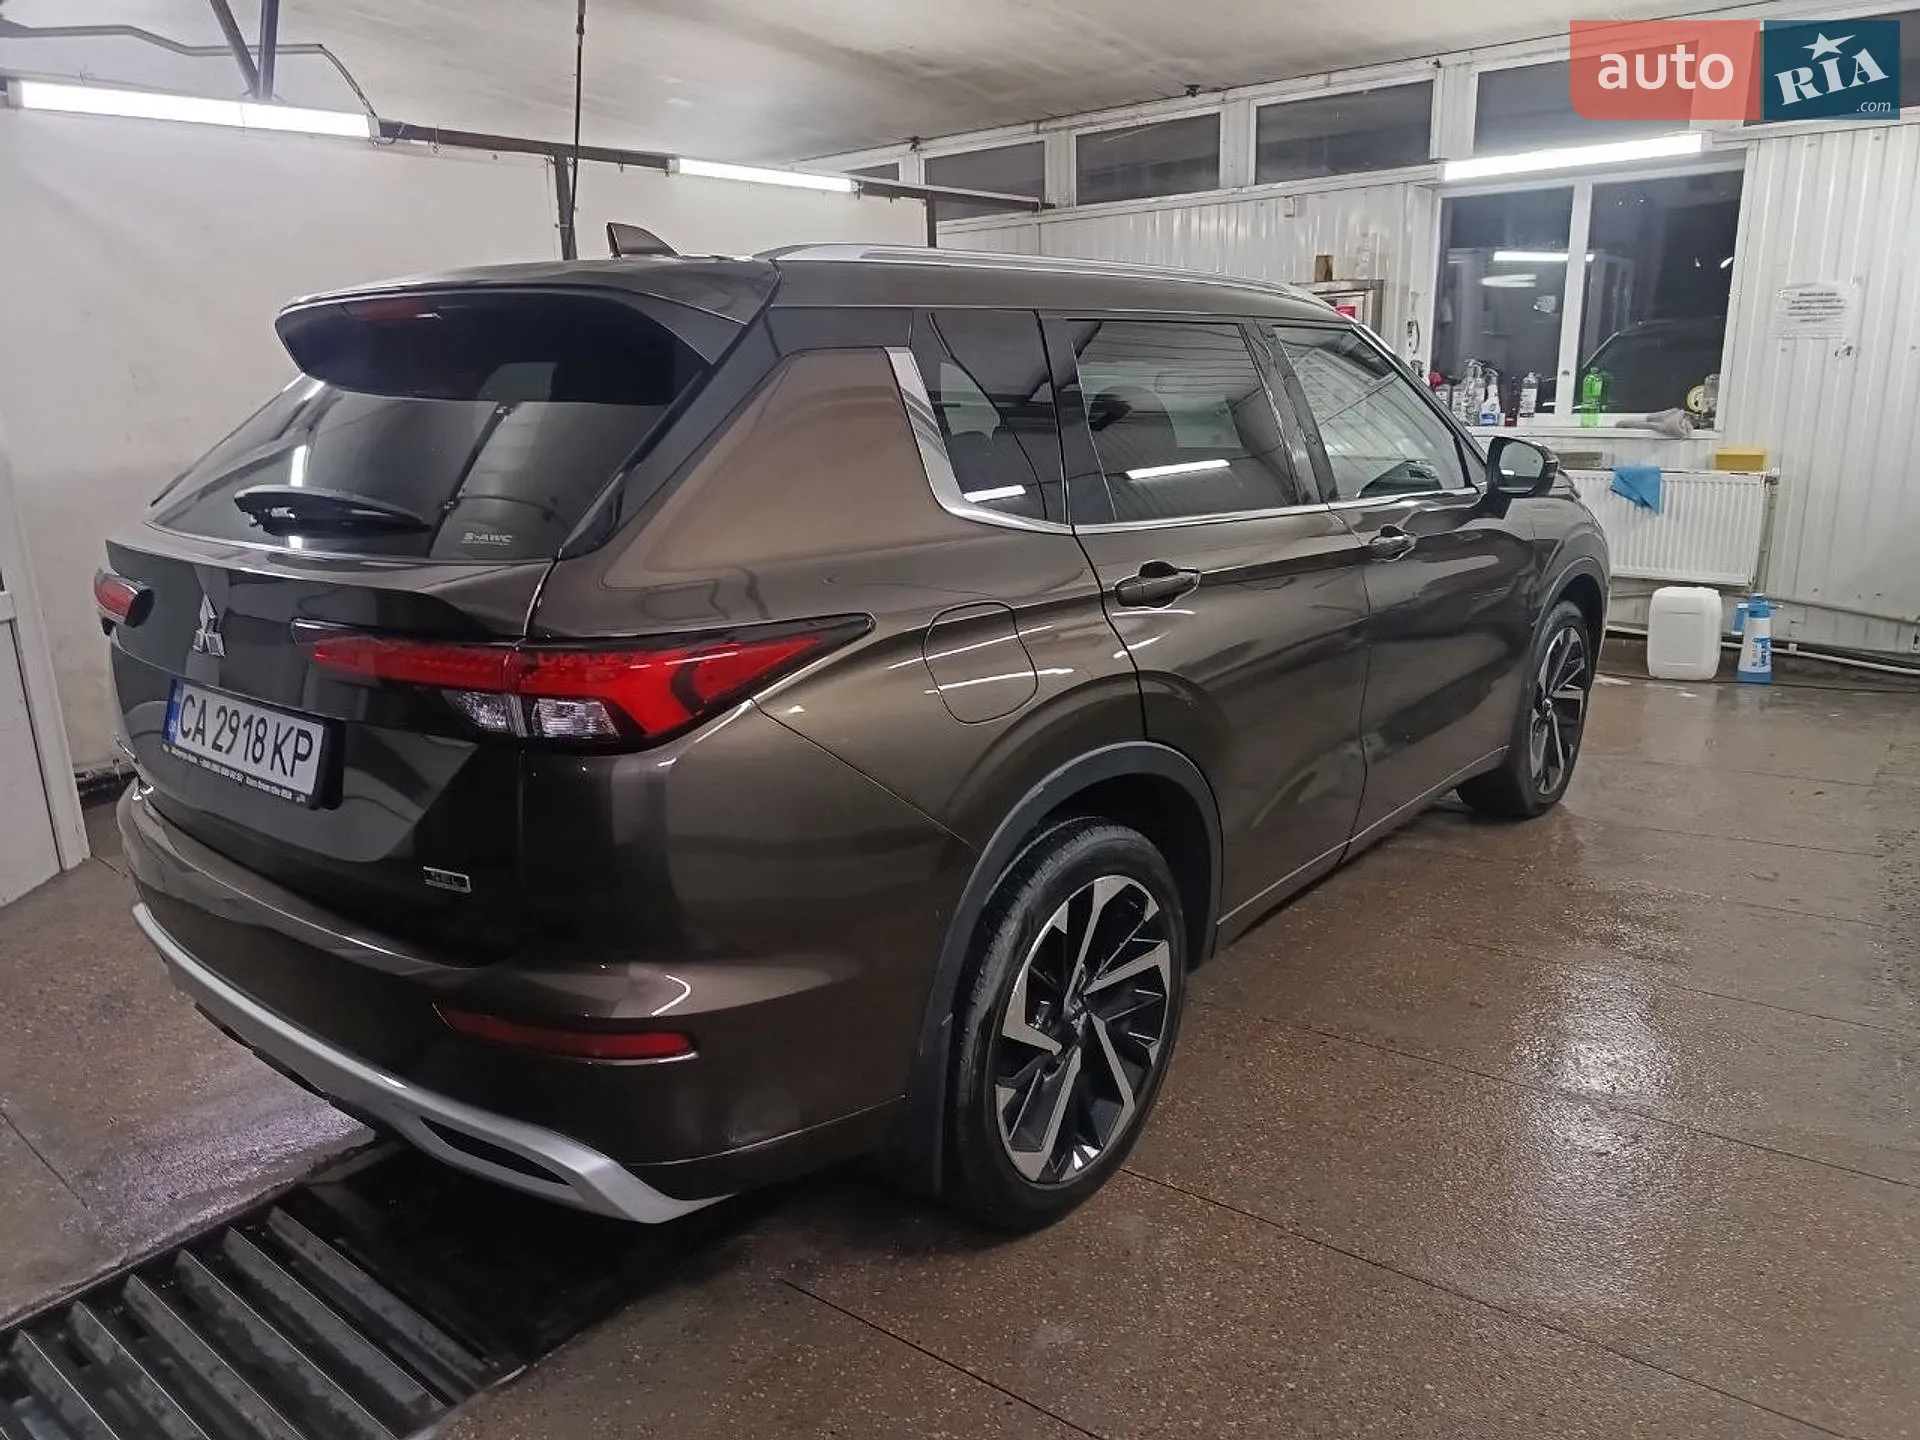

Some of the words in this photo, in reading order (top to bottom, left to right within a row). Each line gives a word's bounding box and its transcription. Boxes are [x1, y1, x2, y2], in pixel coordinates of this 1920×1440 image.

[179, 694, 207, 747] CA
[211, 705, 268, 765] 2918
[270, 722, 313, 777] KP
